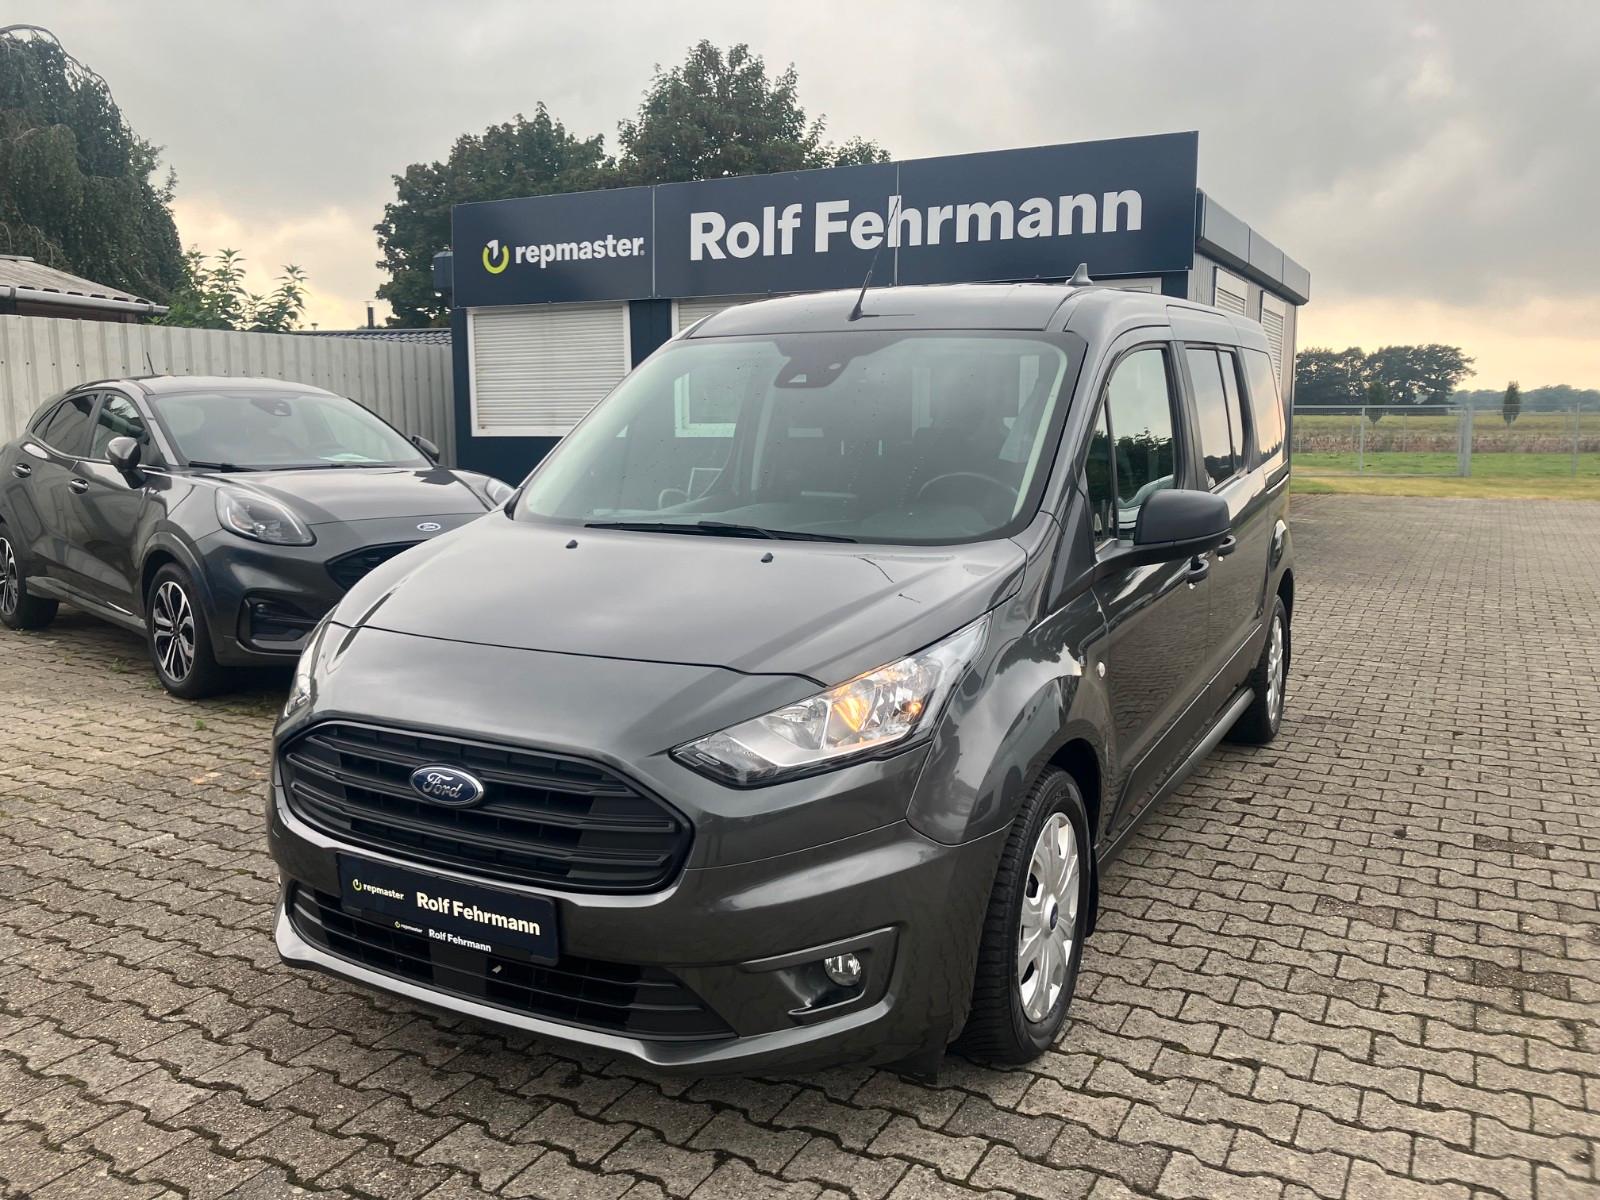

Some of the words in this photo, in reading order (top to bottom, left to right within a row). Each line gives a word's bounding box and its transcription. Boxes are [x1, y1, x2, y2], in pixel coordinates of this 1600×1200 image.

[690, 203, 802, 261] Rolf
[815, 188, 1142, 253] Fehrmann
[515, 234, 645, 269] repmaster
[422, 772, 465, 799] Ford
[363, 882, 405, 901] repmaster
[416, 892, 450, 914] Rolf
[453, 900, 541, 936] Fehrmann
[428, 928, 447, 941] Rolf
[447, 933, 492, 953] Fehrmann
